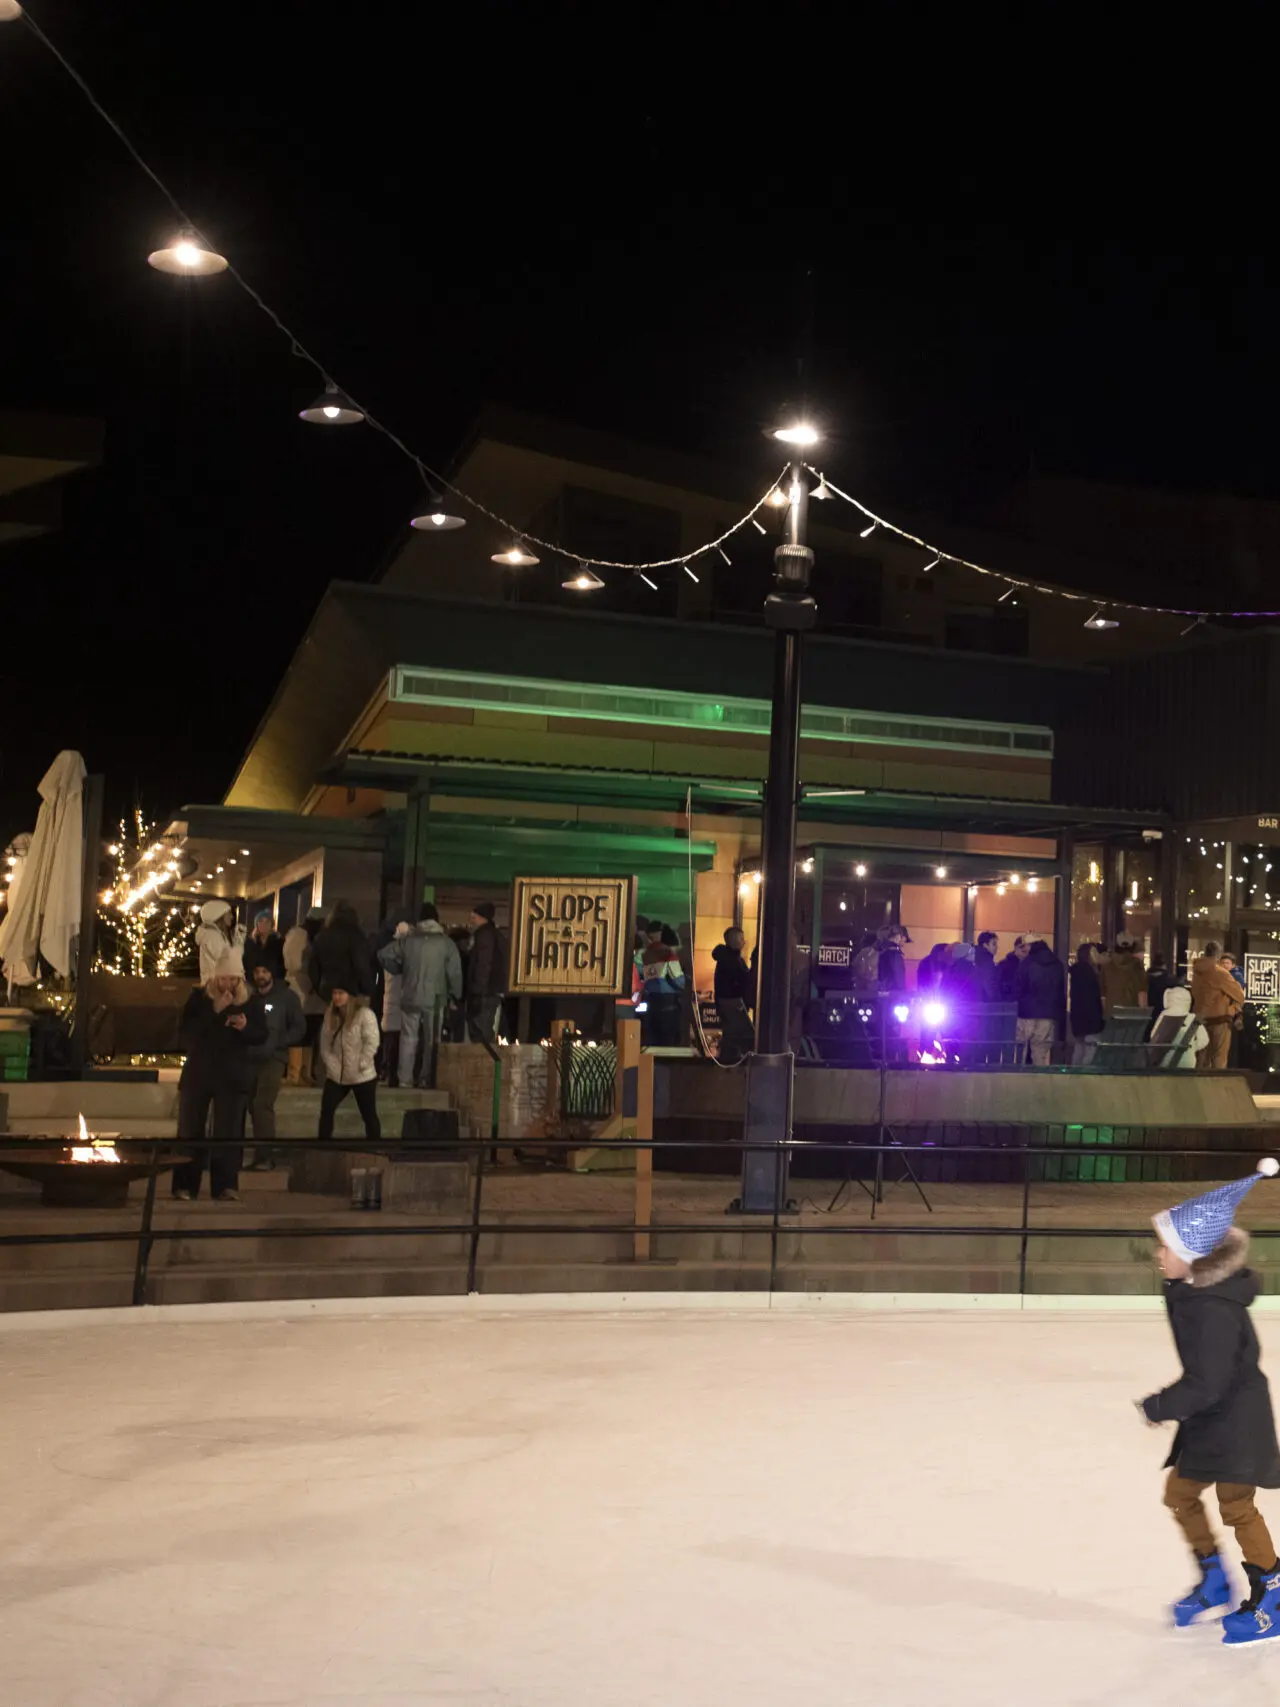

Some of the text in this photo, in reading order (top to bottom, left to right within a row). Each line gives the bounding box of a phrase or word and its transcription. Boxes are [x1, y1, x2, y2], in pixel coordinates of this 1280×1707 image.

[1257, 817, 1278, 829] BAR
[528, 893, 609, 923] SLOPE
[525, 920, 609, 978] HATCH
[819, 947, 850, 967] HATCH
[1248, 959, 1279, 974] SLOPE
[1247, 972, 1279, 999] HATCH
